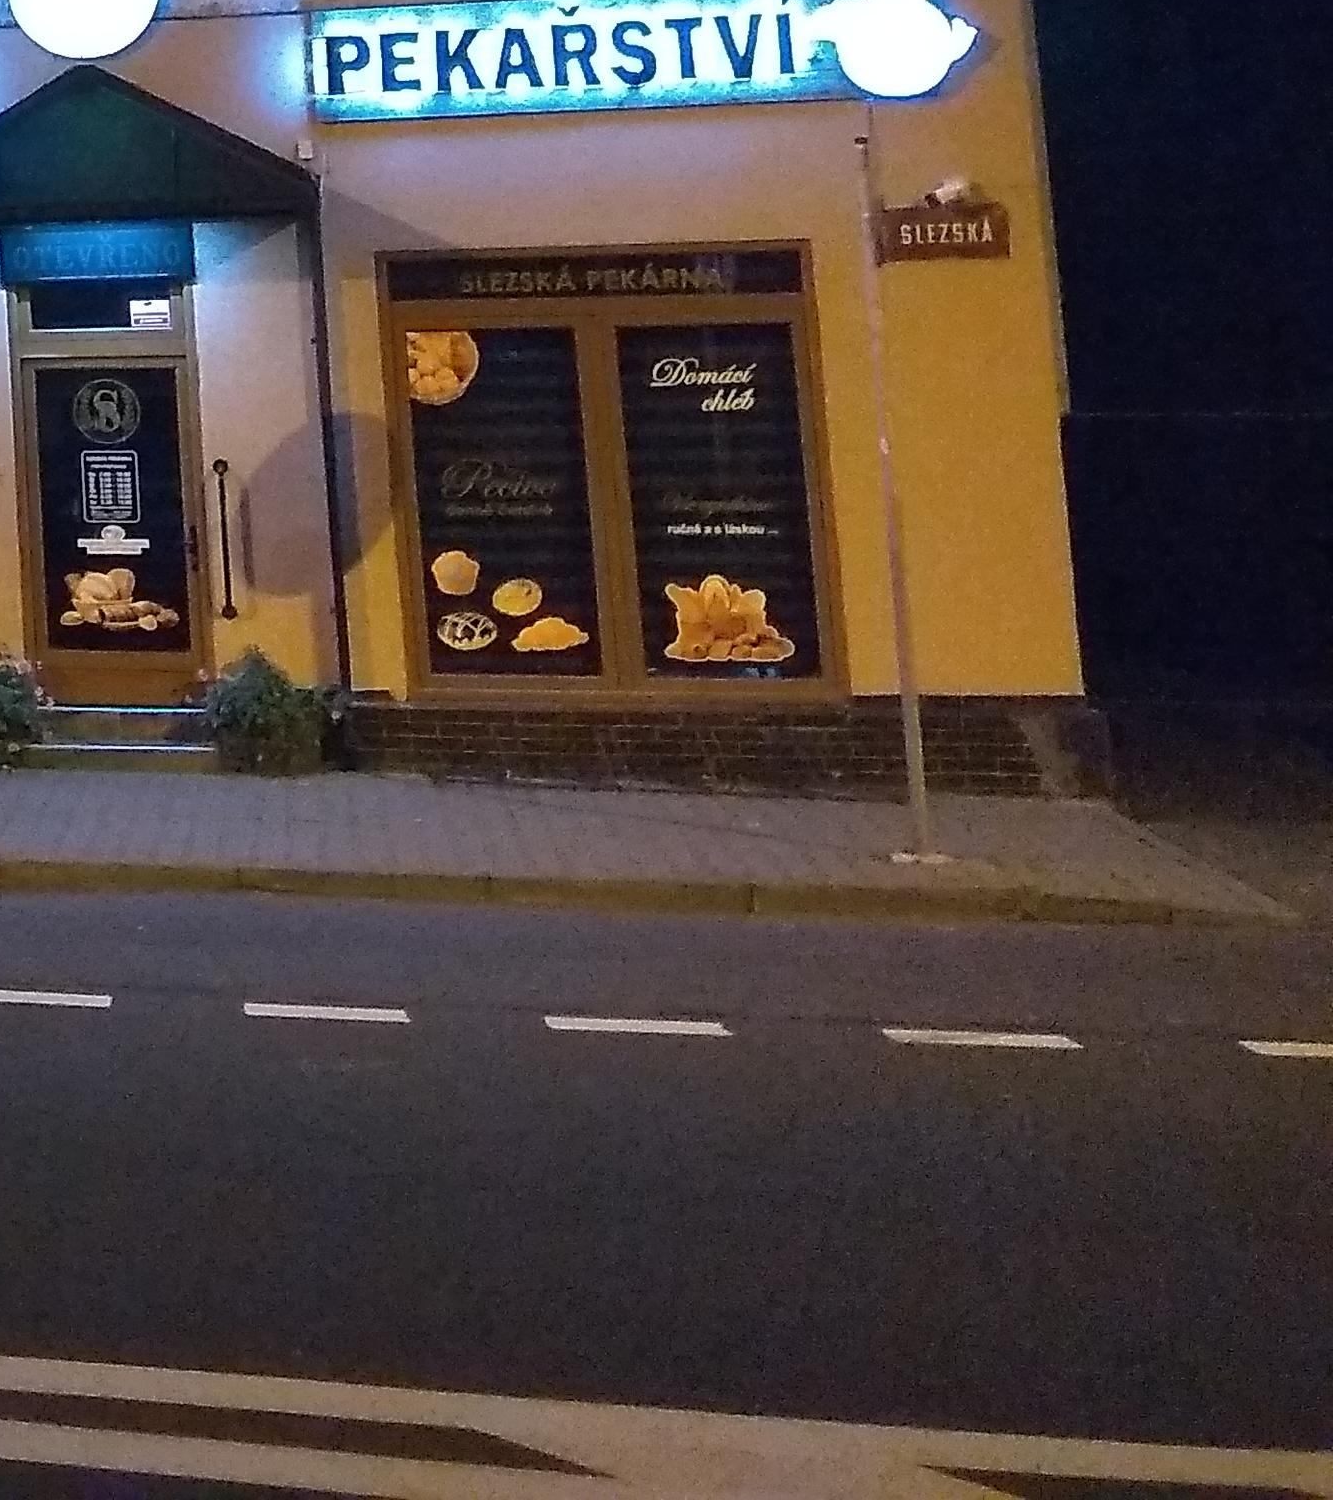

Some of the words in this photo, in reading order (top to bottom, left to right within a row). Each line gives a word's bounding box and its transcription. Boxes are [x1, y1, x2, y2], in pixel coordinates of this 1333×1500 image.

[899, 216, 994, 245] SLEZSKÁ
[460, 263, 577, 293] SLEZSKÁ
[649, 357, 758, 388] Domácí
[700, 387, 755, 412] chléb
